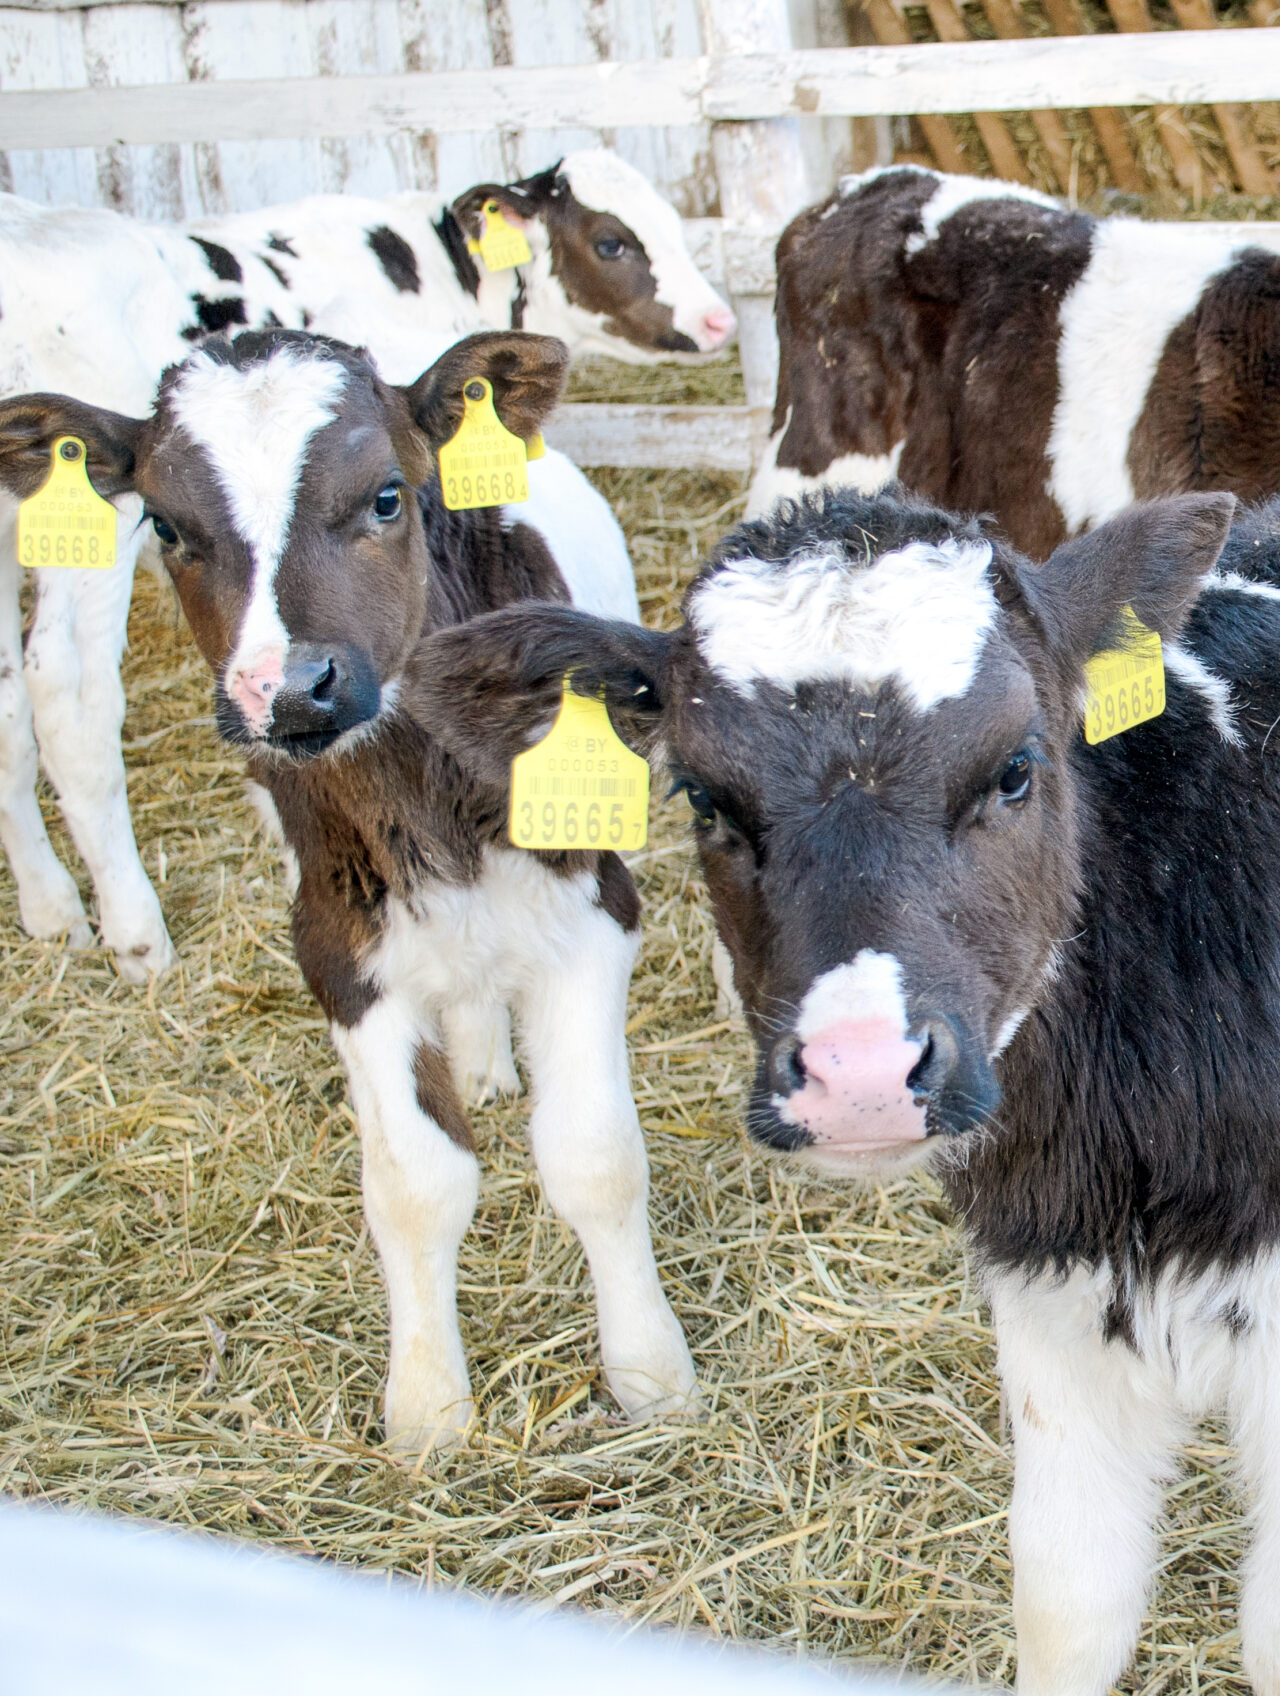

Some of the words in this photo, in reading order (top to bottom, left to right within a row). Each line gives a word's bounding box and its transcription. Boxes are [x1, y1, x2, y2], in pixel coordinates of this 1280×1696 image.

[448, 472, 515, 505] 39668
[23, 534, 100, 565] 39668
[1091, 675, 1154, 738] 39665
[586, 738, 608, 753] BY
[548, 758, 619, 773] 000053
[519, 800, 624, 844] 39665
